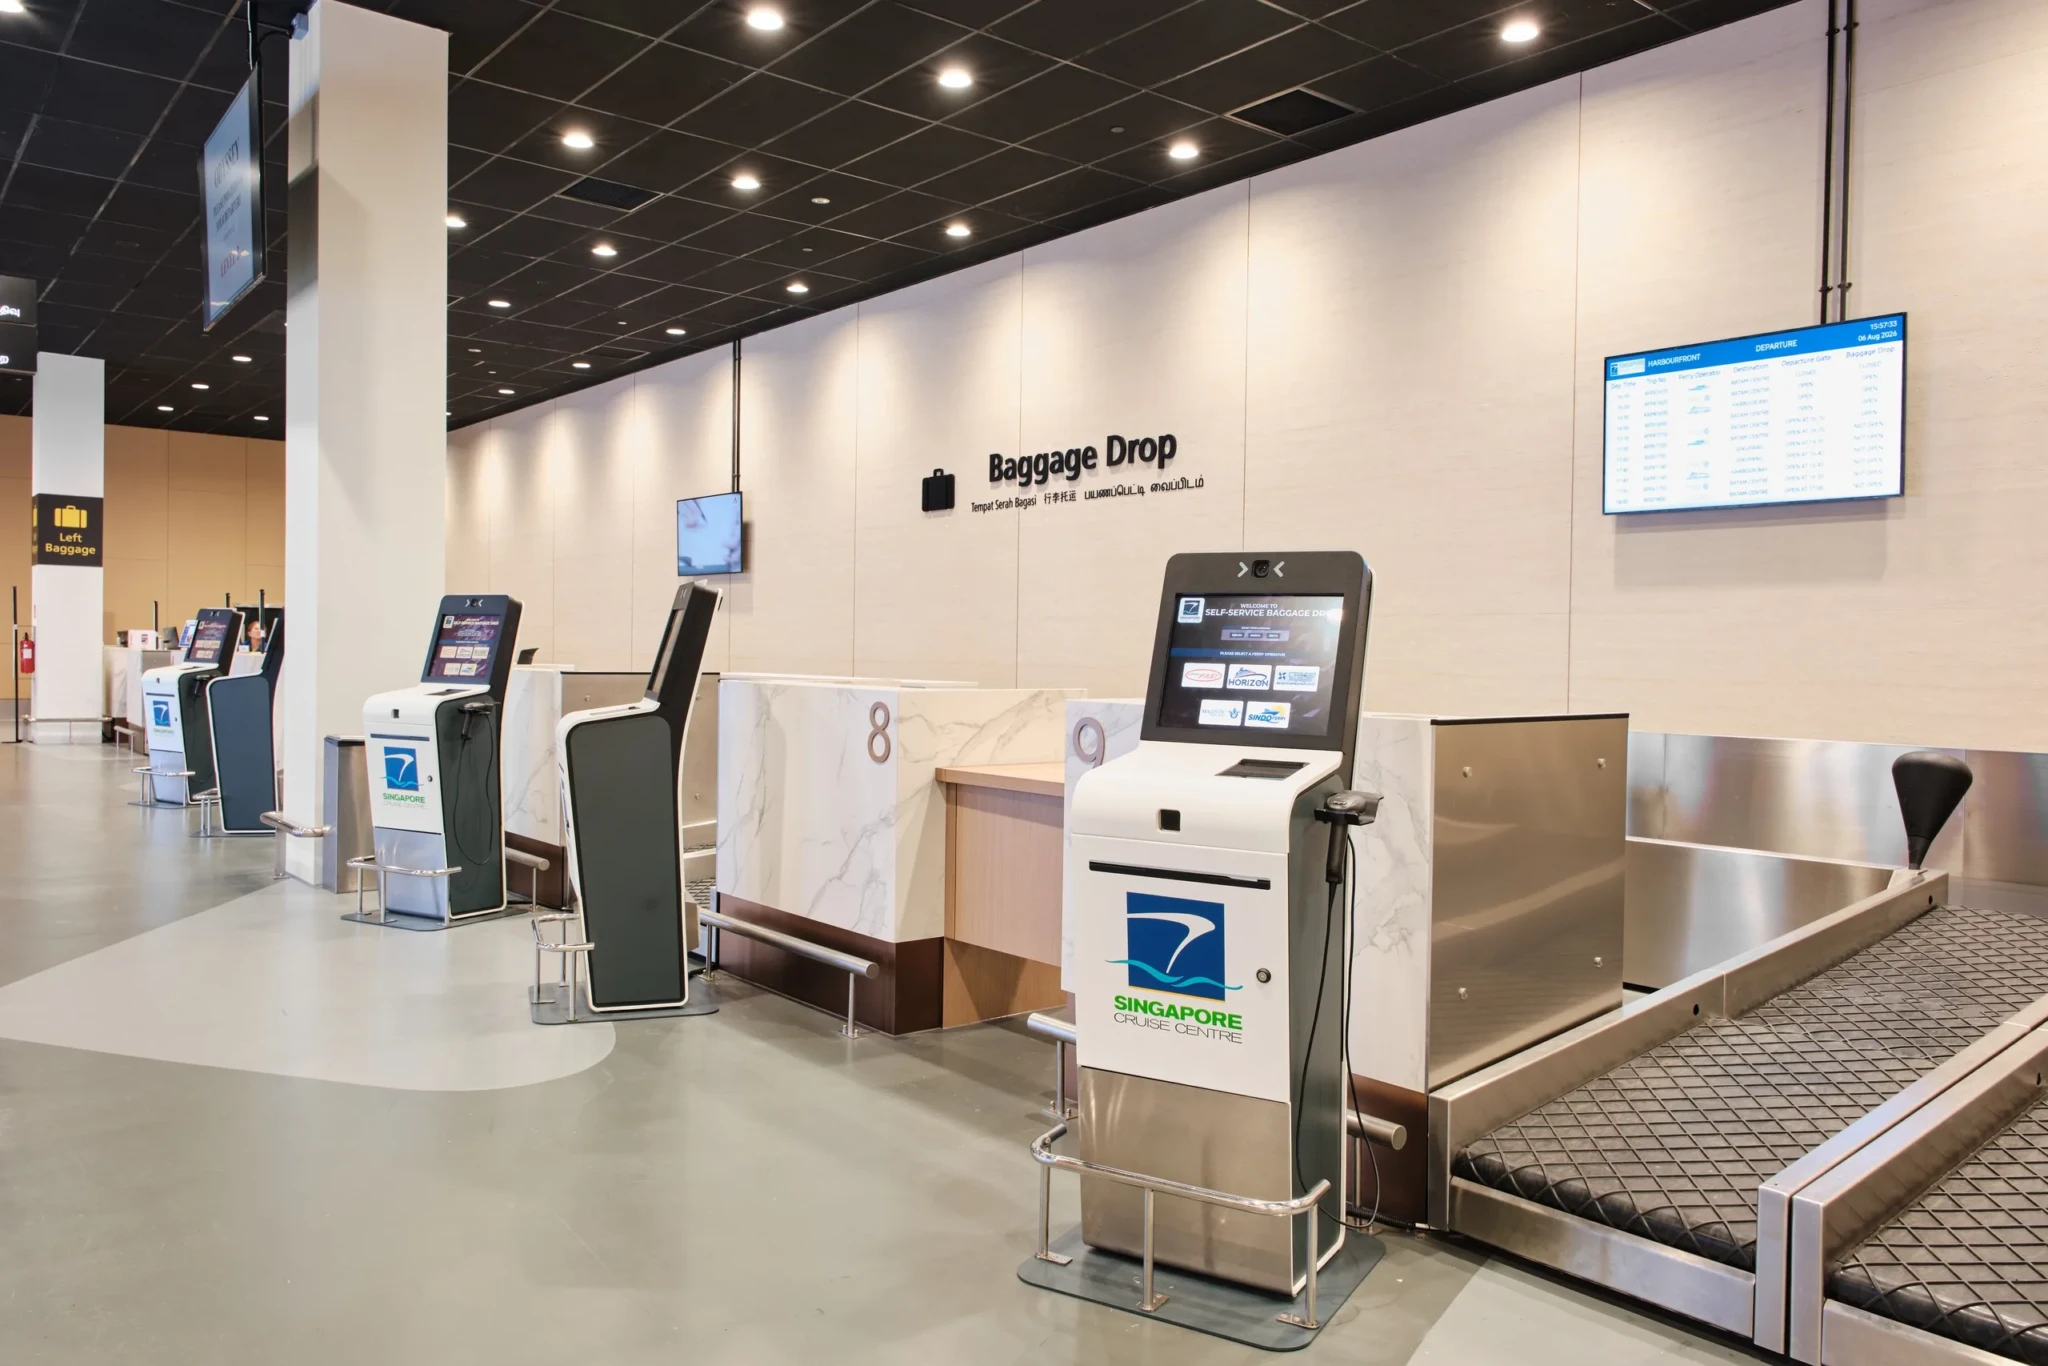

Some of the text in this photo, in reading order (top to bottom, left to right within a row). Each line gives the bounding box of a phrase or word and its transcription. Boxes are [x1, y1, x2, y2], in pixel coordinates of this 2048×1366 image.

[1870, 320, 1898, 330] 15:57:33
[1880, 330, 1898, 339] 2026
[1755, 340, 1798, 352] DEPARTURE
[1846, 346, 1896, 360] Baggage Drop
[1648, 353, 1701, 368] HARBOURFRONT
[1782, 358, 1814, 368] Departure
[1695, 370, 1721, 379] Operator
[1733, 364, 1769, 374] Destination
[989, 434, 1177, 487] Baggage Drop
[1150, 474, 1204, 492] வைப்பிடம்
[1044, 490, 1076, 504] 行李托运
[971, 494, 1037, 514] Tempat Serah Bagasi
[60, 532, 82, 542] Left
[45, 543, 96, 556] Baggage
[1204, 609, 1265, 617] SELF-SERVICE
[1228, 679, 1268, 687] HORIZON
[868, 701, 891, 764] 8
[1072, 716, 1105, 769] 9
[382, 792, 426, 804] SINGAPORE
[1114, 995, 1243, 1030] SINGAPORE
[1114, 1012, 1244, 1044] CRUISE CENTRE
